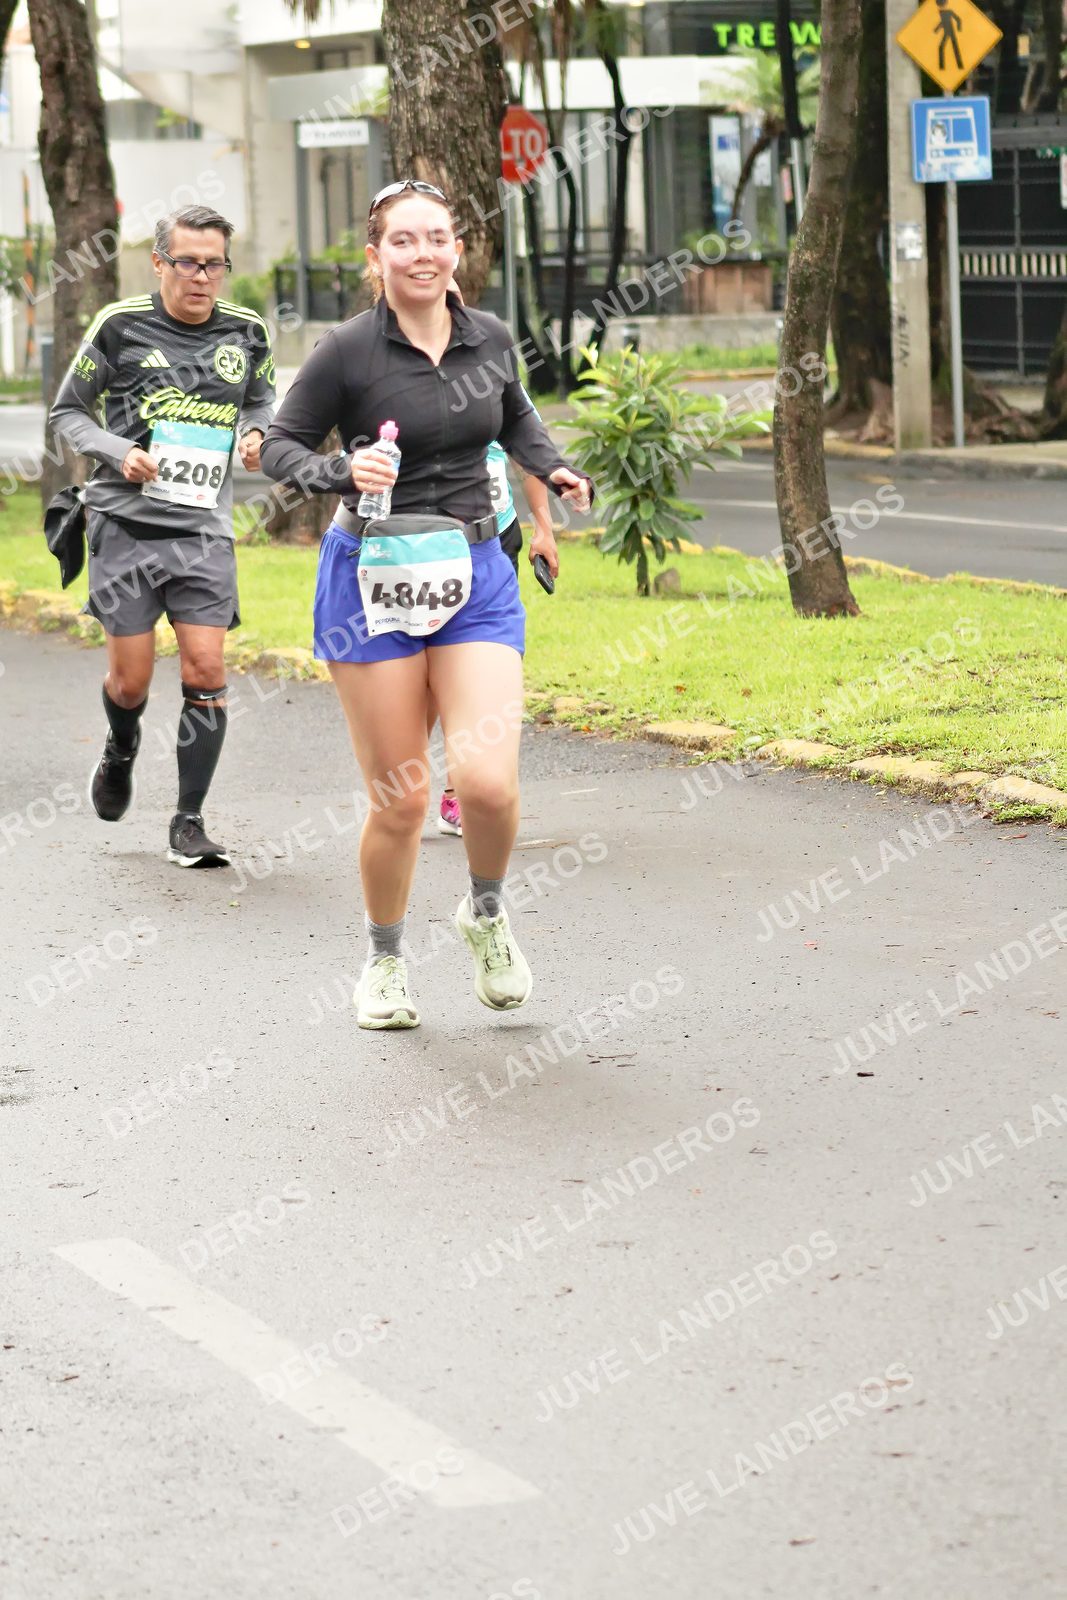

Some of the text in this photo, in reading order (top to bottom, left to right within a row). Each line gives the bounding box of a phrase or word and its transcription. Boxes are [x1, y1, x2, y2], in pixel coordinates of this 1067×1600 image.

[713, 21, 776, 48] TRE
[500, 127, 544, 162] LTO
[139, 386, 238, 424] Caliente
[157, 457, 222, 489] 4208
[371, 578, 463, 611] 4848
